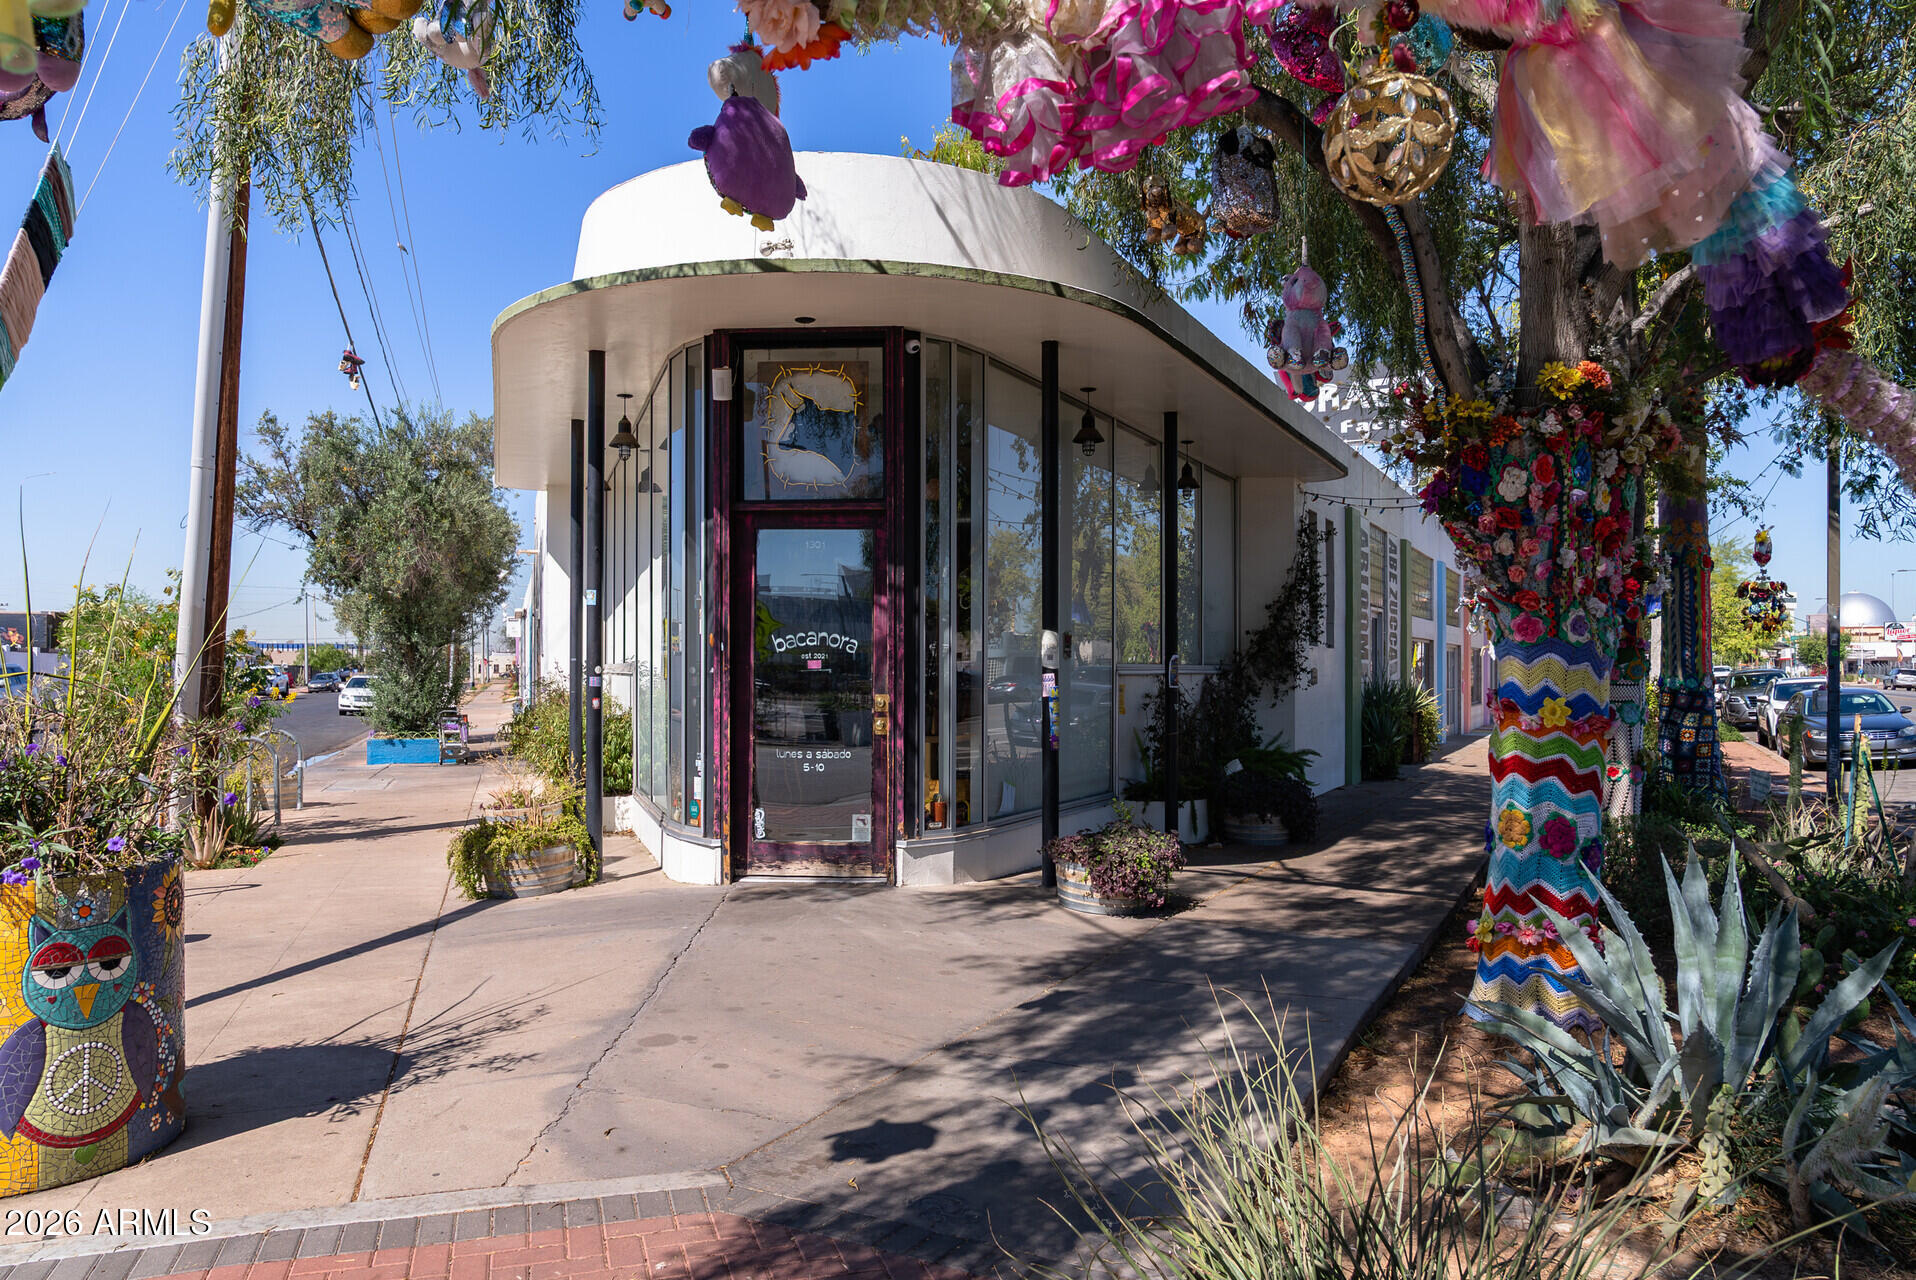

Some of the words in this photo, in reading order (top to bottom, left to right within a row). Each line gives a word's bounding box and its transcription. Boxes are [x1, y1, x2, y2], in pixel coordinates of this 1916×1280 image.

[1389, 538, 1398, 585] ABE
[1389, 588, 1398, 660] ZUCCA
[771, 631, 858, 654] bacanora
[776, 748, 803, 759] lunes
[805, 750, 813, 759] a
[803, 763, 825, 772] 5-10
